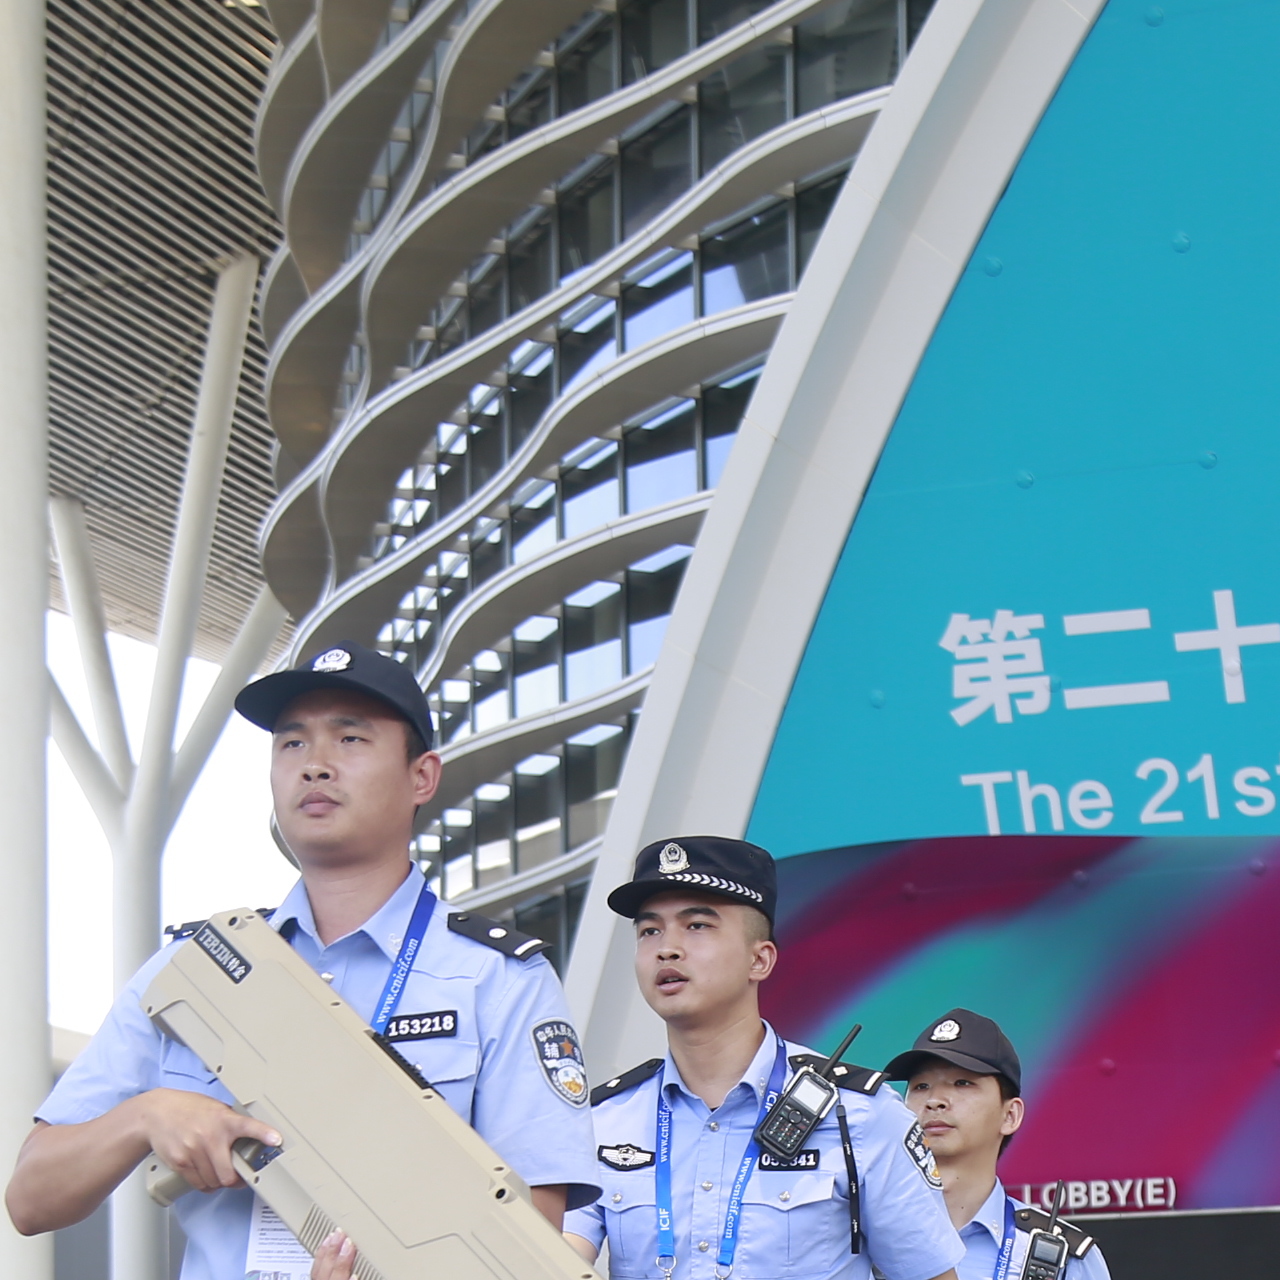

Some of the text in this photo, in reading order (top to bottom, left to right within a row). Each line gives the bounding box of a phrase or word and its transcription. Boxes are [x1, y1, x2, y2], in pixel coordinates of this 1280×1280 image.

[961, 767, 1114, 836] The
[376, 938, 419, 1024] www.cnicif.com
[388, 1014, 455, 1037] 153218
[724, 1157, 752, 1239] www.cnicif.com
[1022, 1176, 1177, 1210] LOBBY(E)
[659, 1207, 671, 1231] ICIF
